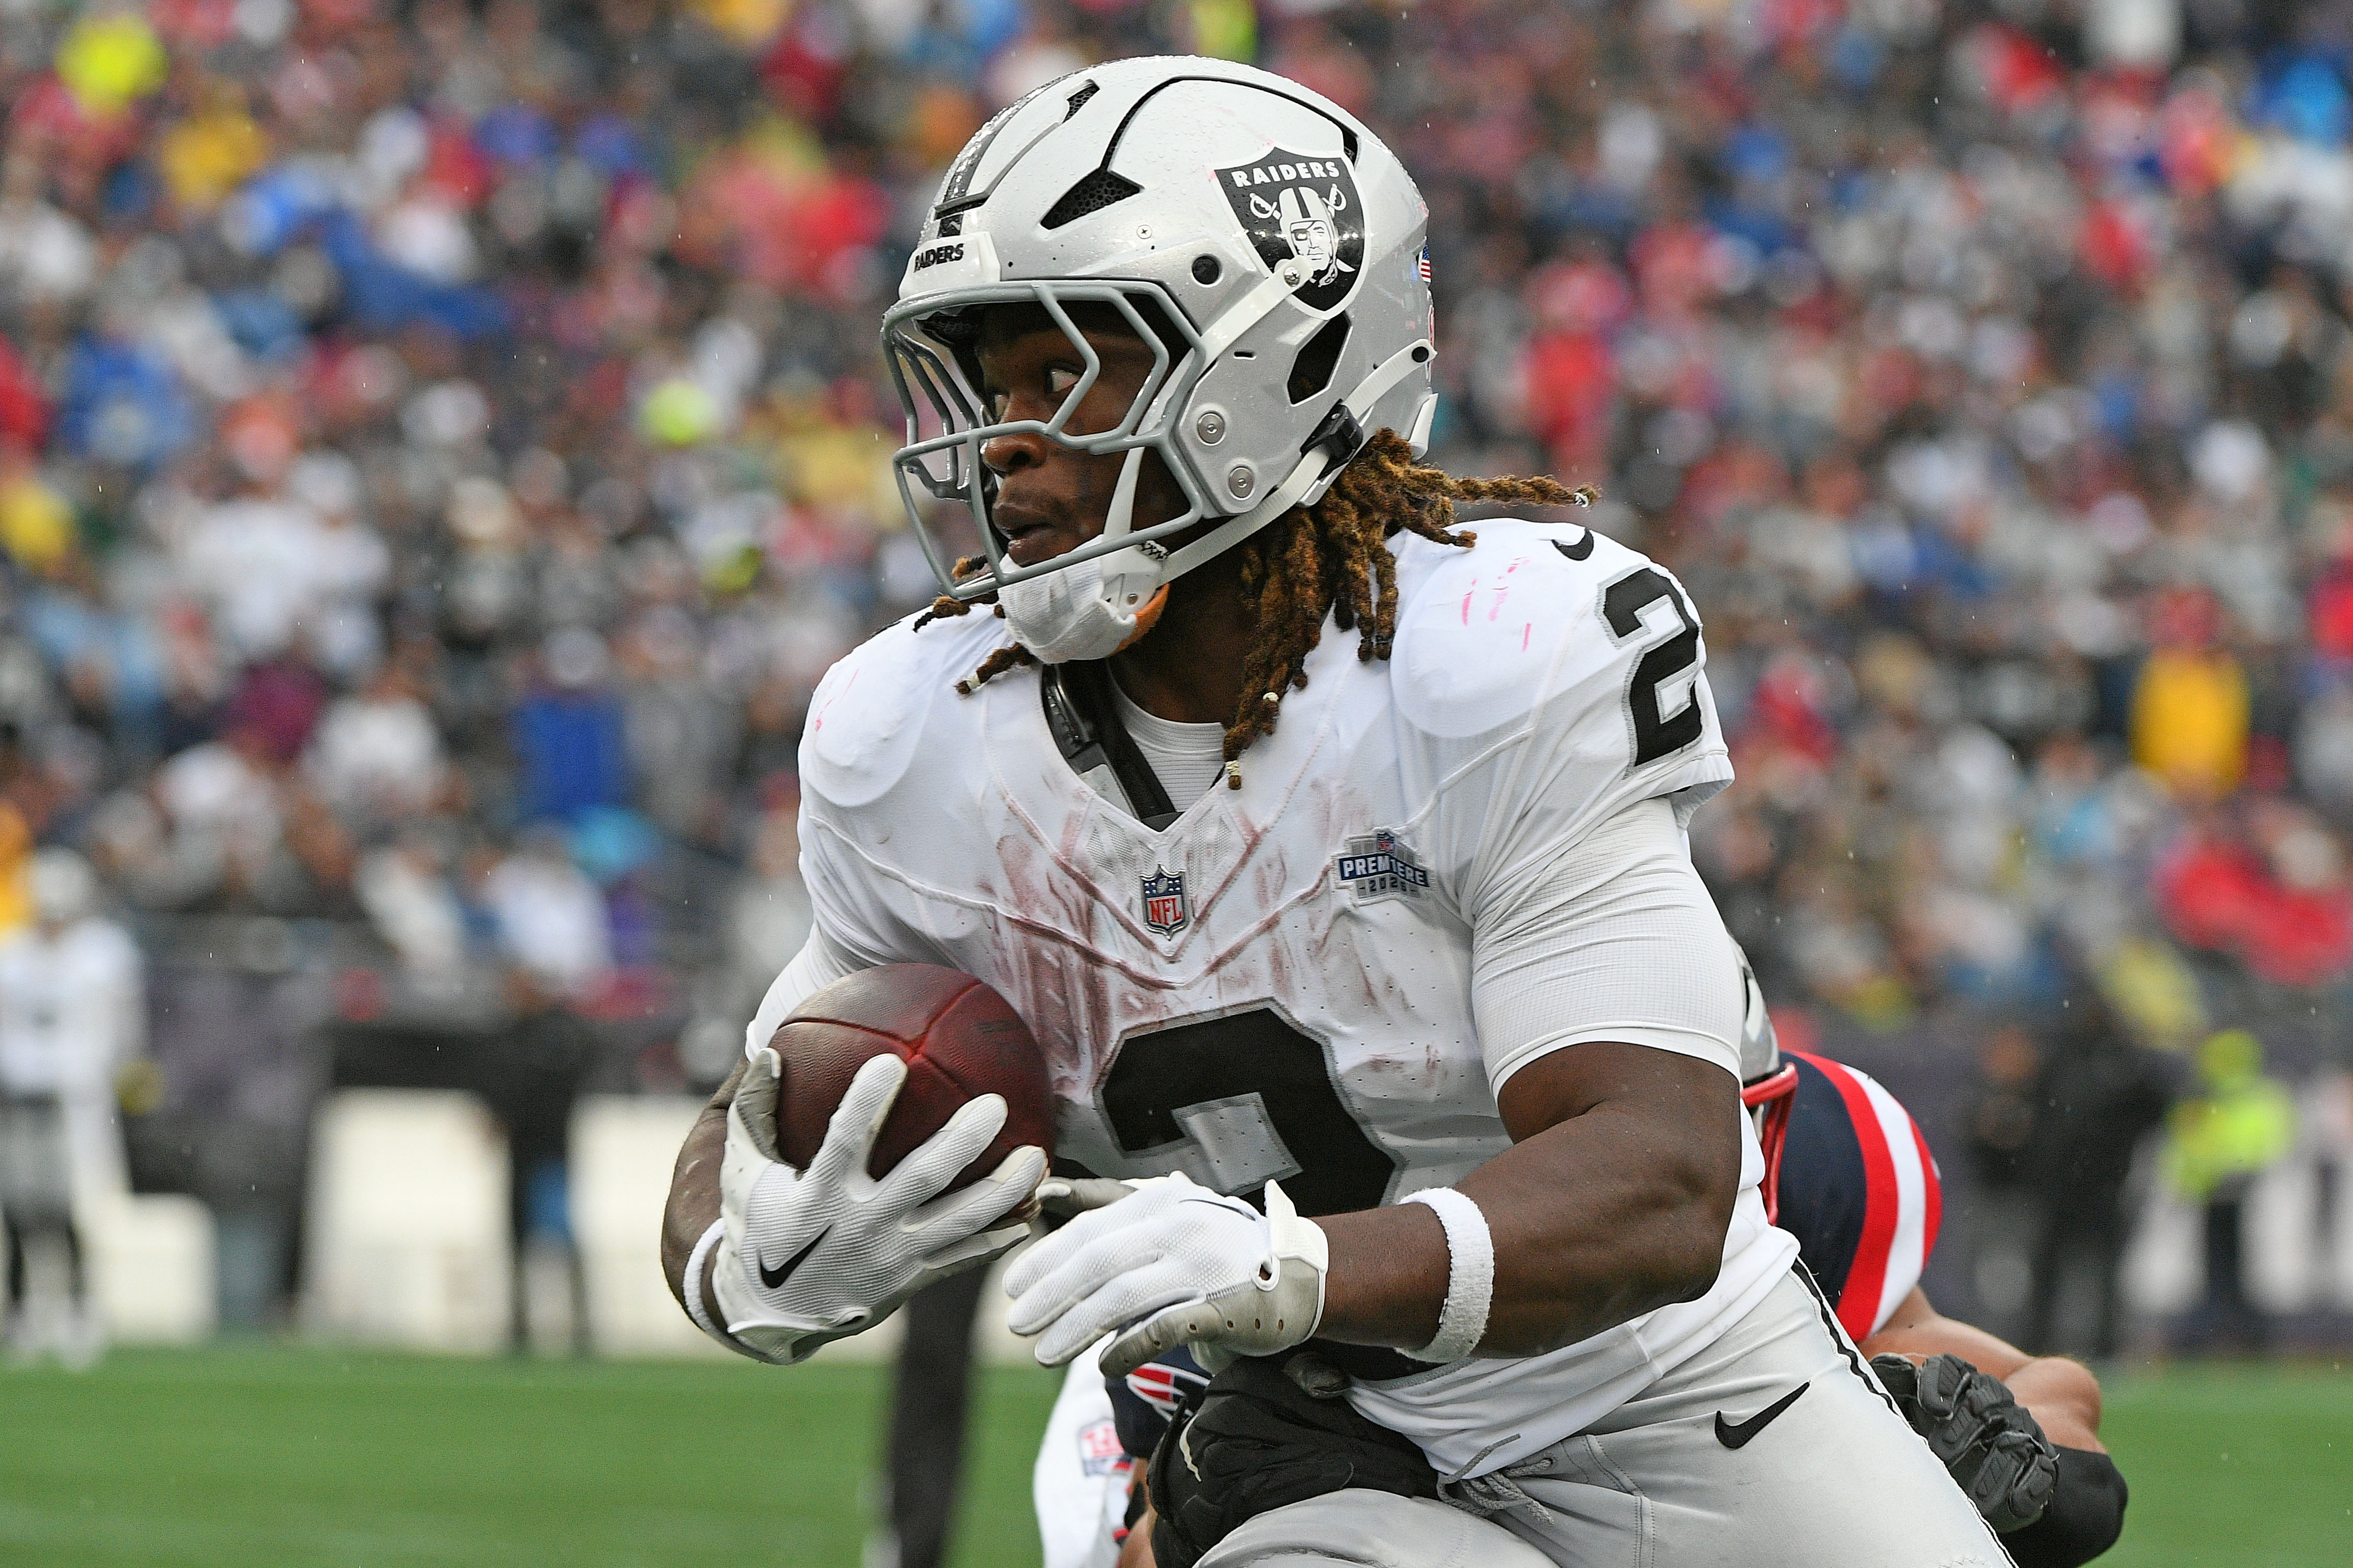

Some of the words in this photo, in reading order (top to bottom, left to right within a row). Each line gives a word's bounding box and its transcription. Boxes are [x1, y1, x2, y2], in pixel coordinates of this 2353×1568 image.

[1230, 162, 1340, 188] RAIDERS
[1596, 564, 1704, 778] 2
[1342, 855, 1426, 885] PREMIERE
[1147, 895, 1183, 925] NFL
